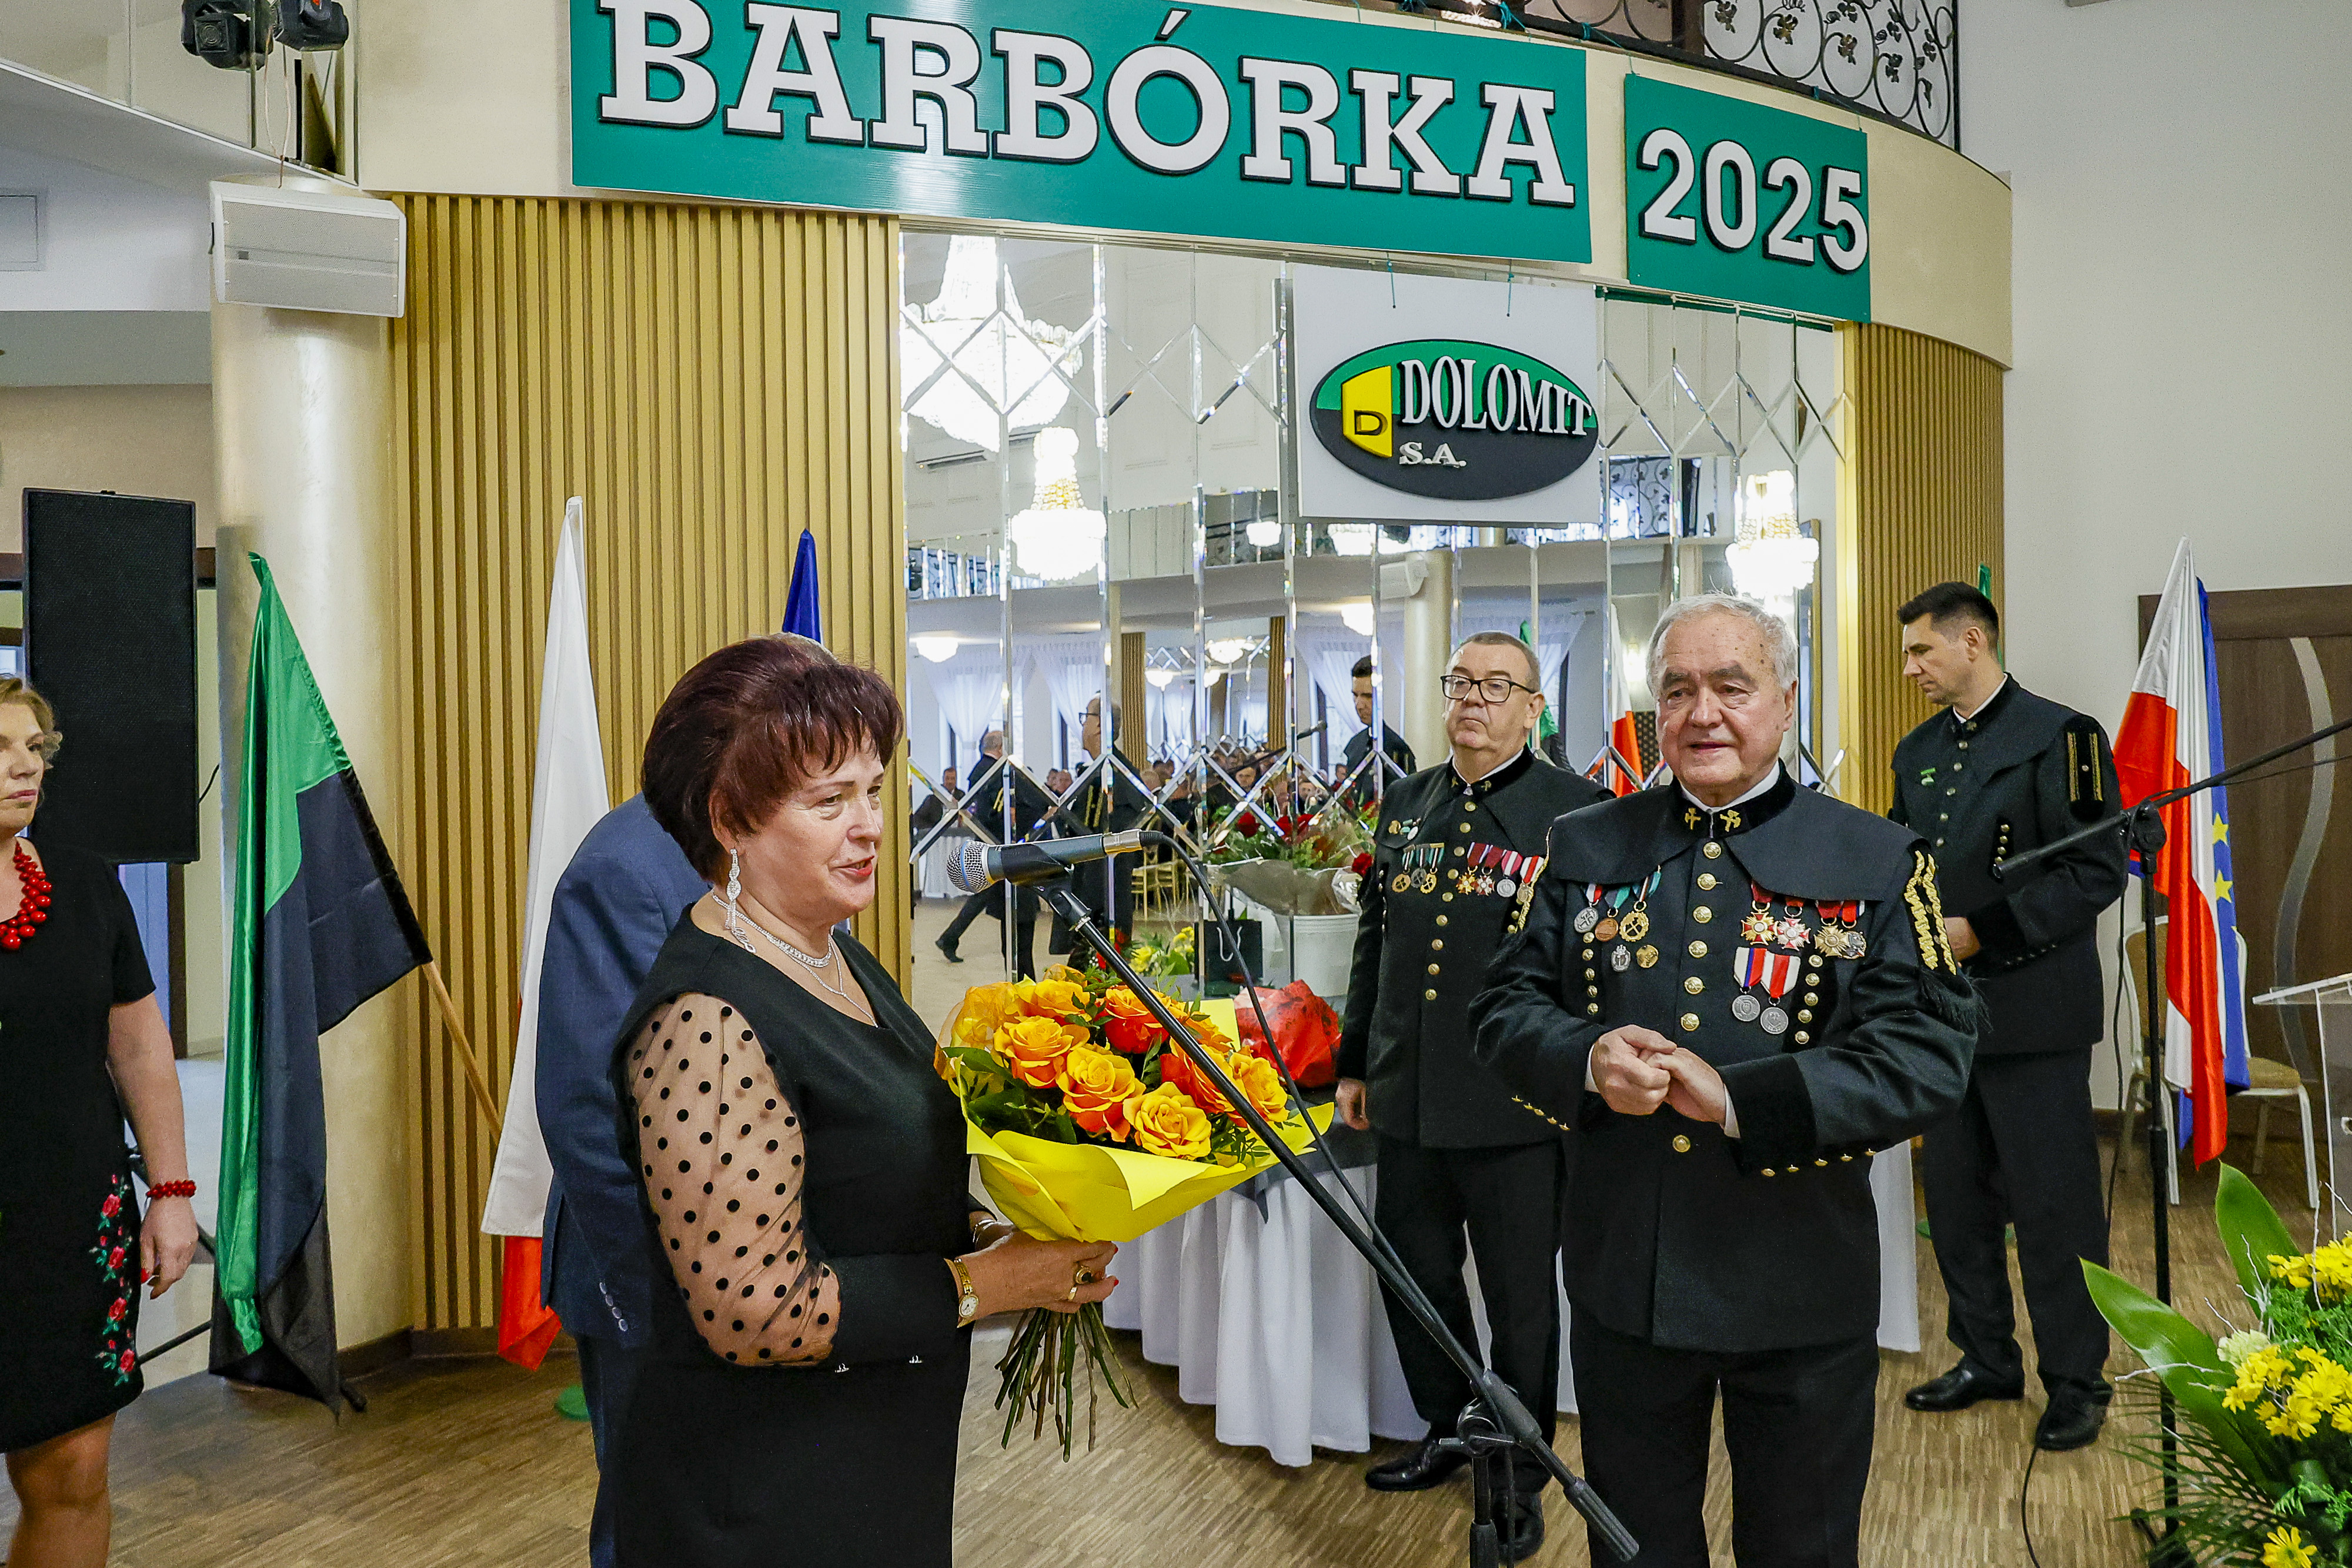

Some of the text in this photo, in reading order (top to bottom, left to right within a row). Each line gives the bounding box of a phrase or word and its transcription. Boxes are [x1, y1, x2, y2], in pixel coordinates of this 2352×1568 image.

[597, 0, 1576, 206] BARBÓRKA
[1637, 128, 1868, 273] 2025
[1354, 410, 1388, 436] D
[1400, 356, 1591, 436] DOLOMIT
[1399, 442, 1467, 467] S.A.
